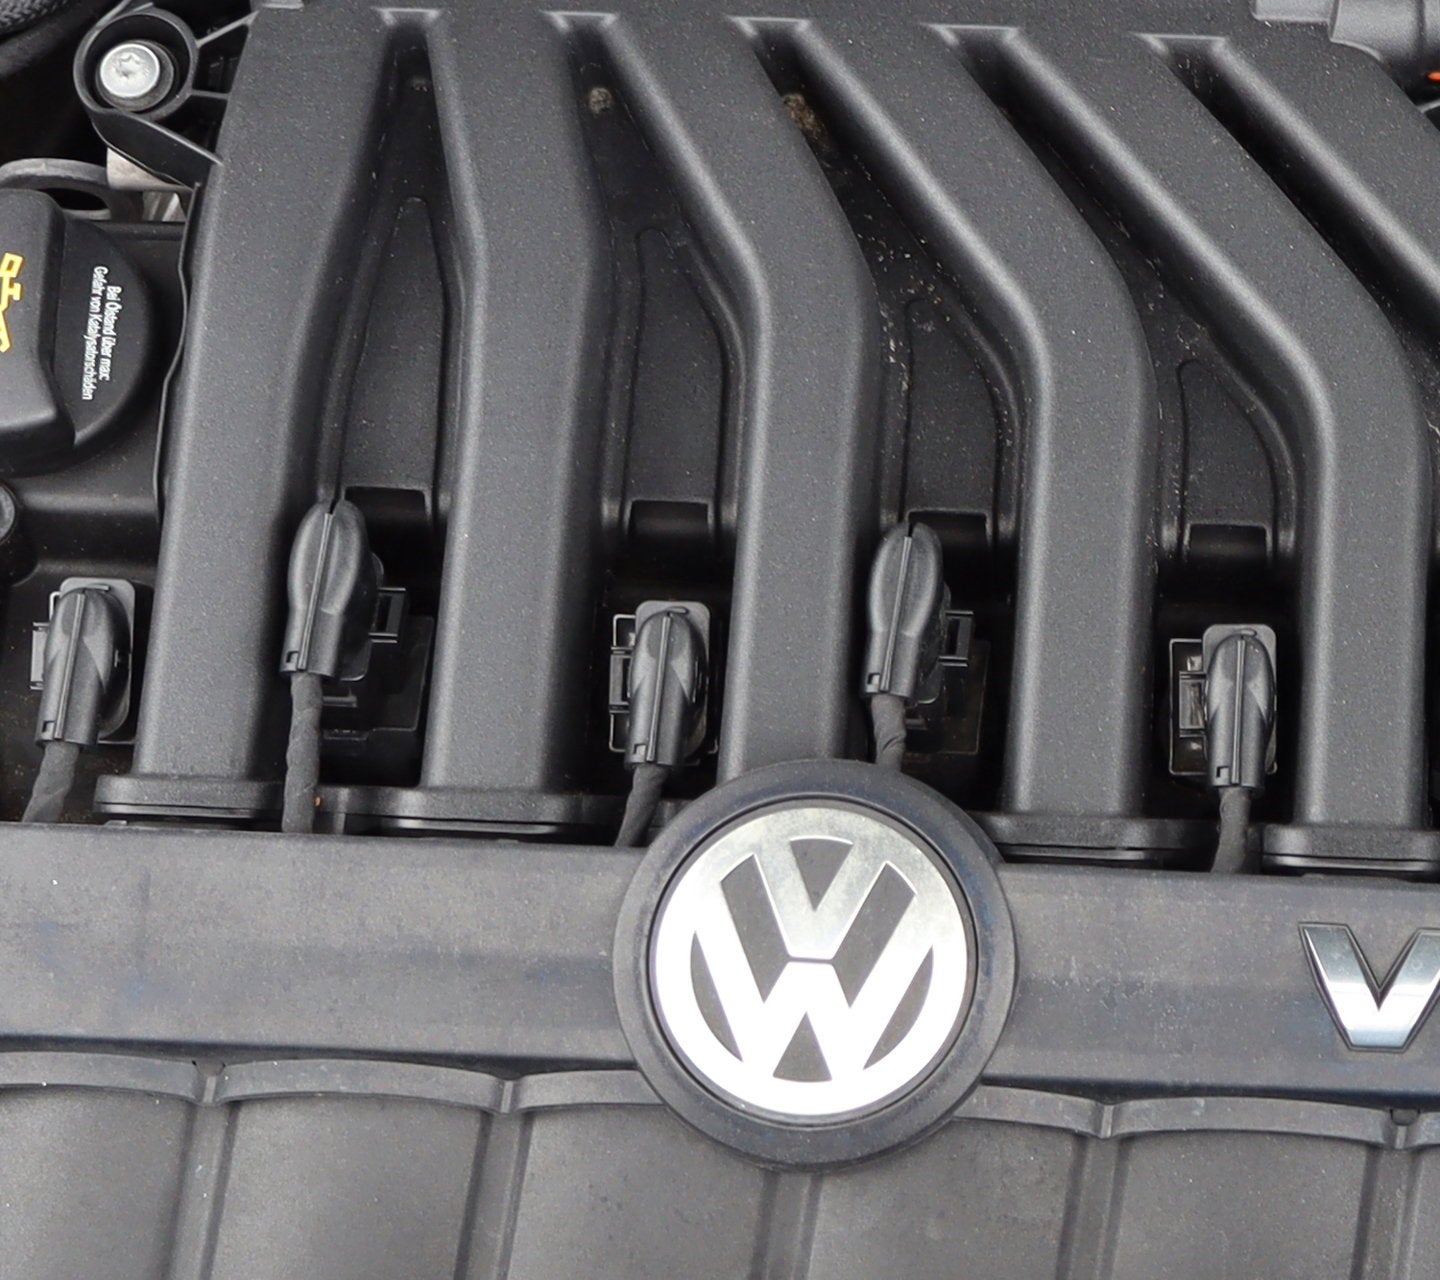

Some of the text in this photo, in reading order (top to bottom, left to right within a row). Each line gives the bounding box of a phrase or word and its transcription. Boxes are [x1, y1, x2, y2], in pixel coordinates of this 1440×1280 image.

[105, 286, 121, 301] Bei
[104, 302, 121, 336] Ölstand
[81, 266, 108, 400] Gefahr von Katalysatorschäden
[101, 337, 116, 357] über
